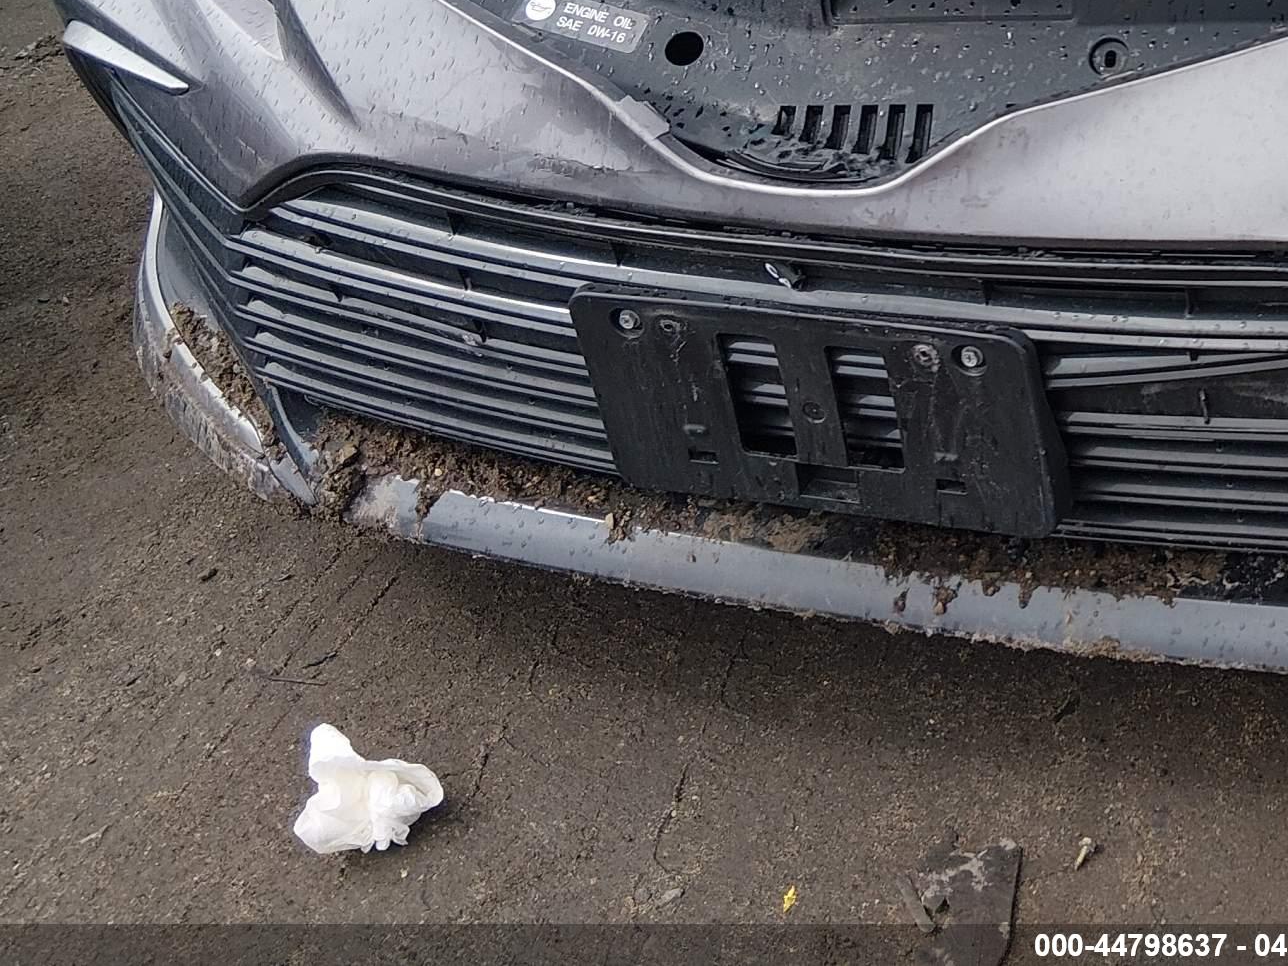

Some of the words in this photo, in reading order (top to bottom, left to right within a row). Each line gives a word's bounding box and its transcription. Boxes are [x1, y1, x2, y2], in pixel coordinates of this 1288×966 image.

[557, 16, 583, 31] SAE
[587, 25, 626, 43] 0W-16
[564, 3, 609, 23] ENGINE
[614, 16, 633, 30] OIL
